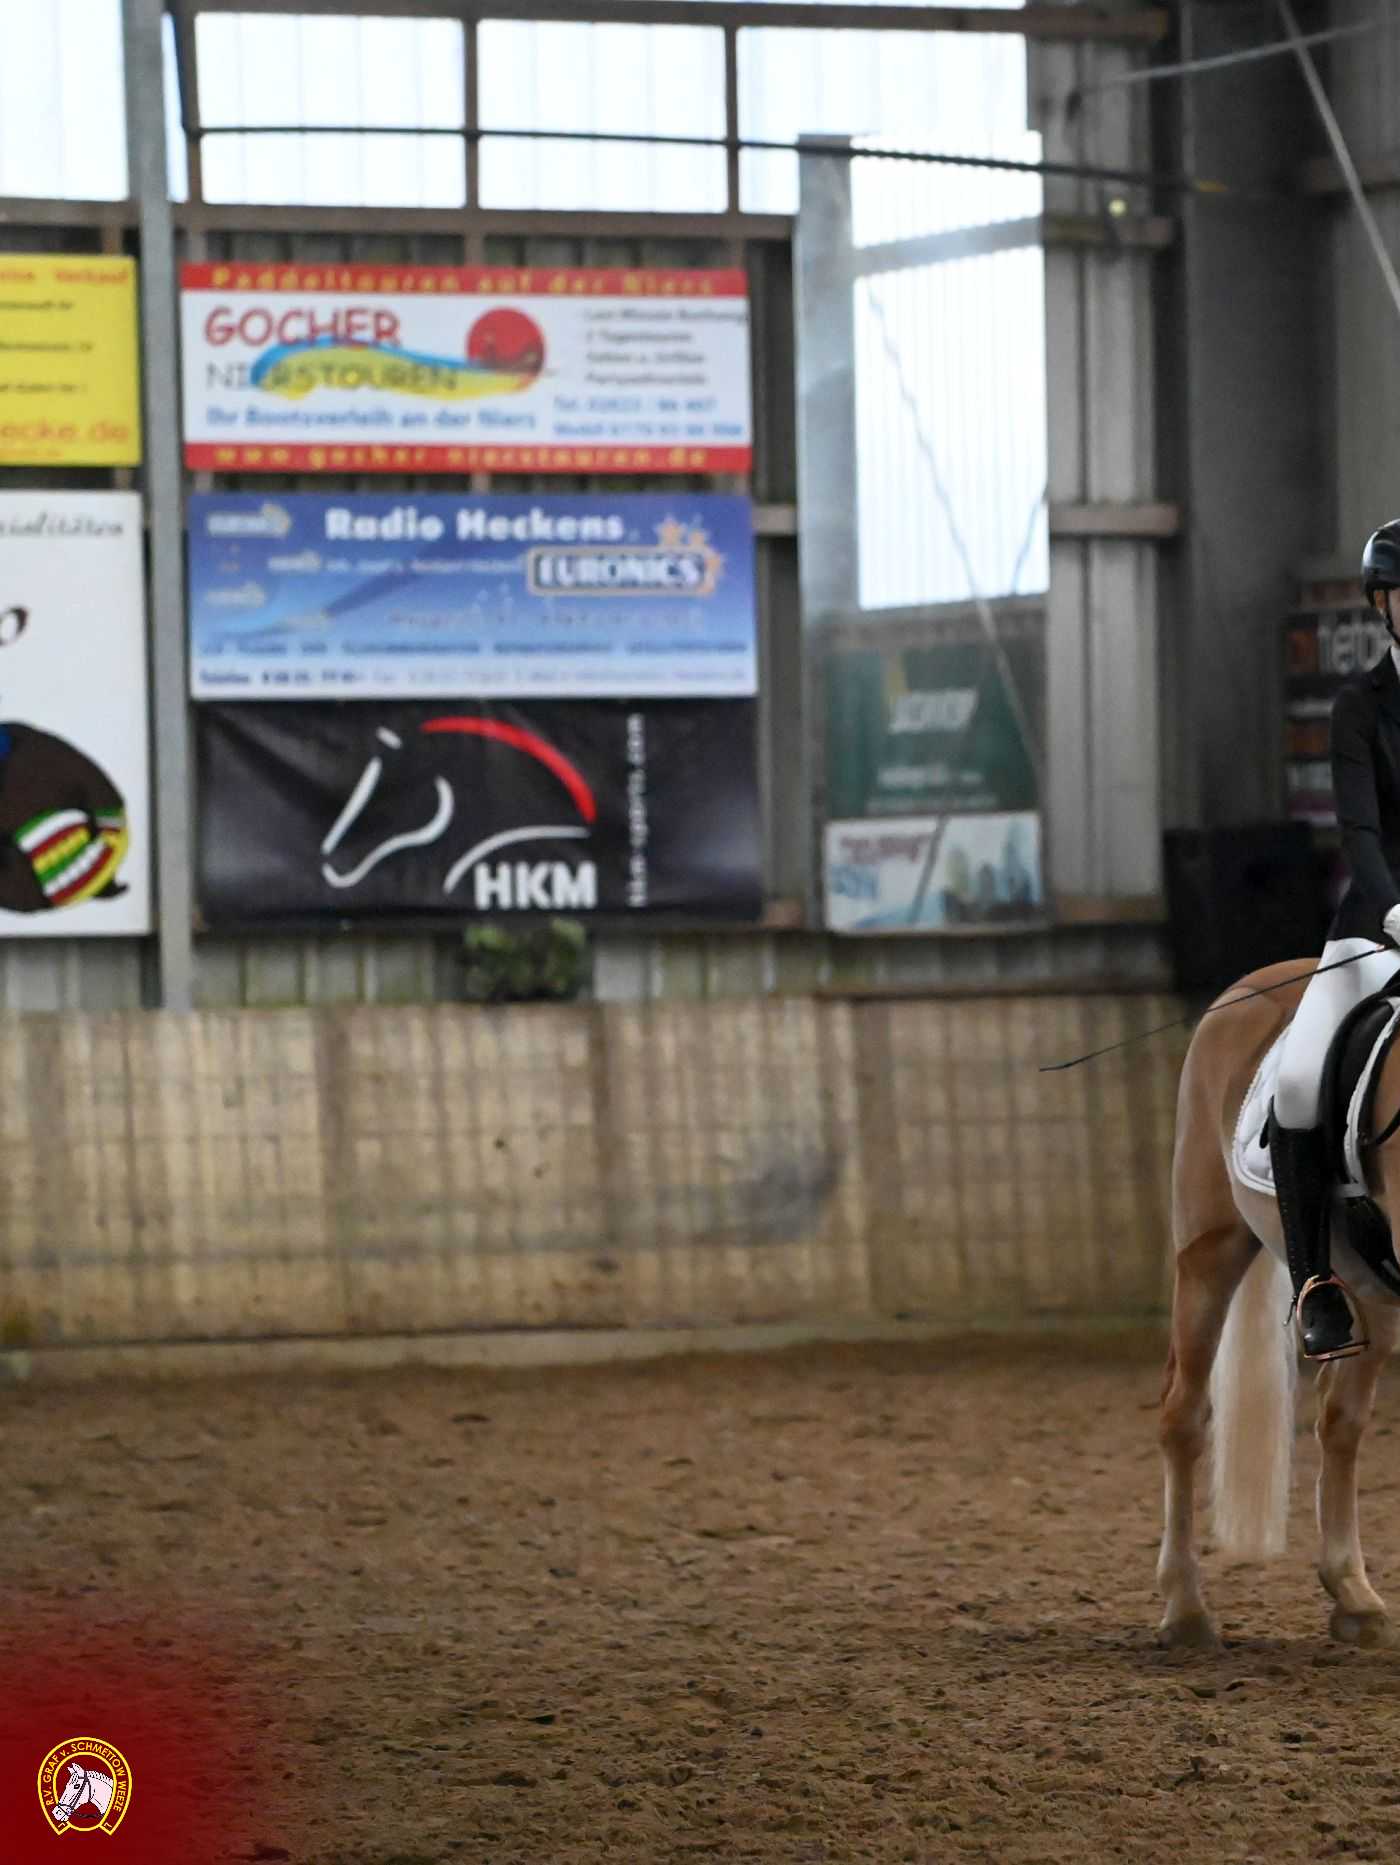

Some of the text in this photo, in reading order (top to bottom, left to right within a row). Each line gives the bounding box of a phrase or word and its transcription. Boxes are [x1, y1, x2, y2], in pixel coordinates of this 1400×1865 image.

[479, 273, 532, 291] auf
[552, 273, 604, 292] der
[204, 305, 402, 347] GOCHER
[324, 506, 445, 541] Radio
[456, 507, 624, 541] Heckens
[537, 554, 702, 586] EURONICS
[474, 861, 597, 911] HKM
